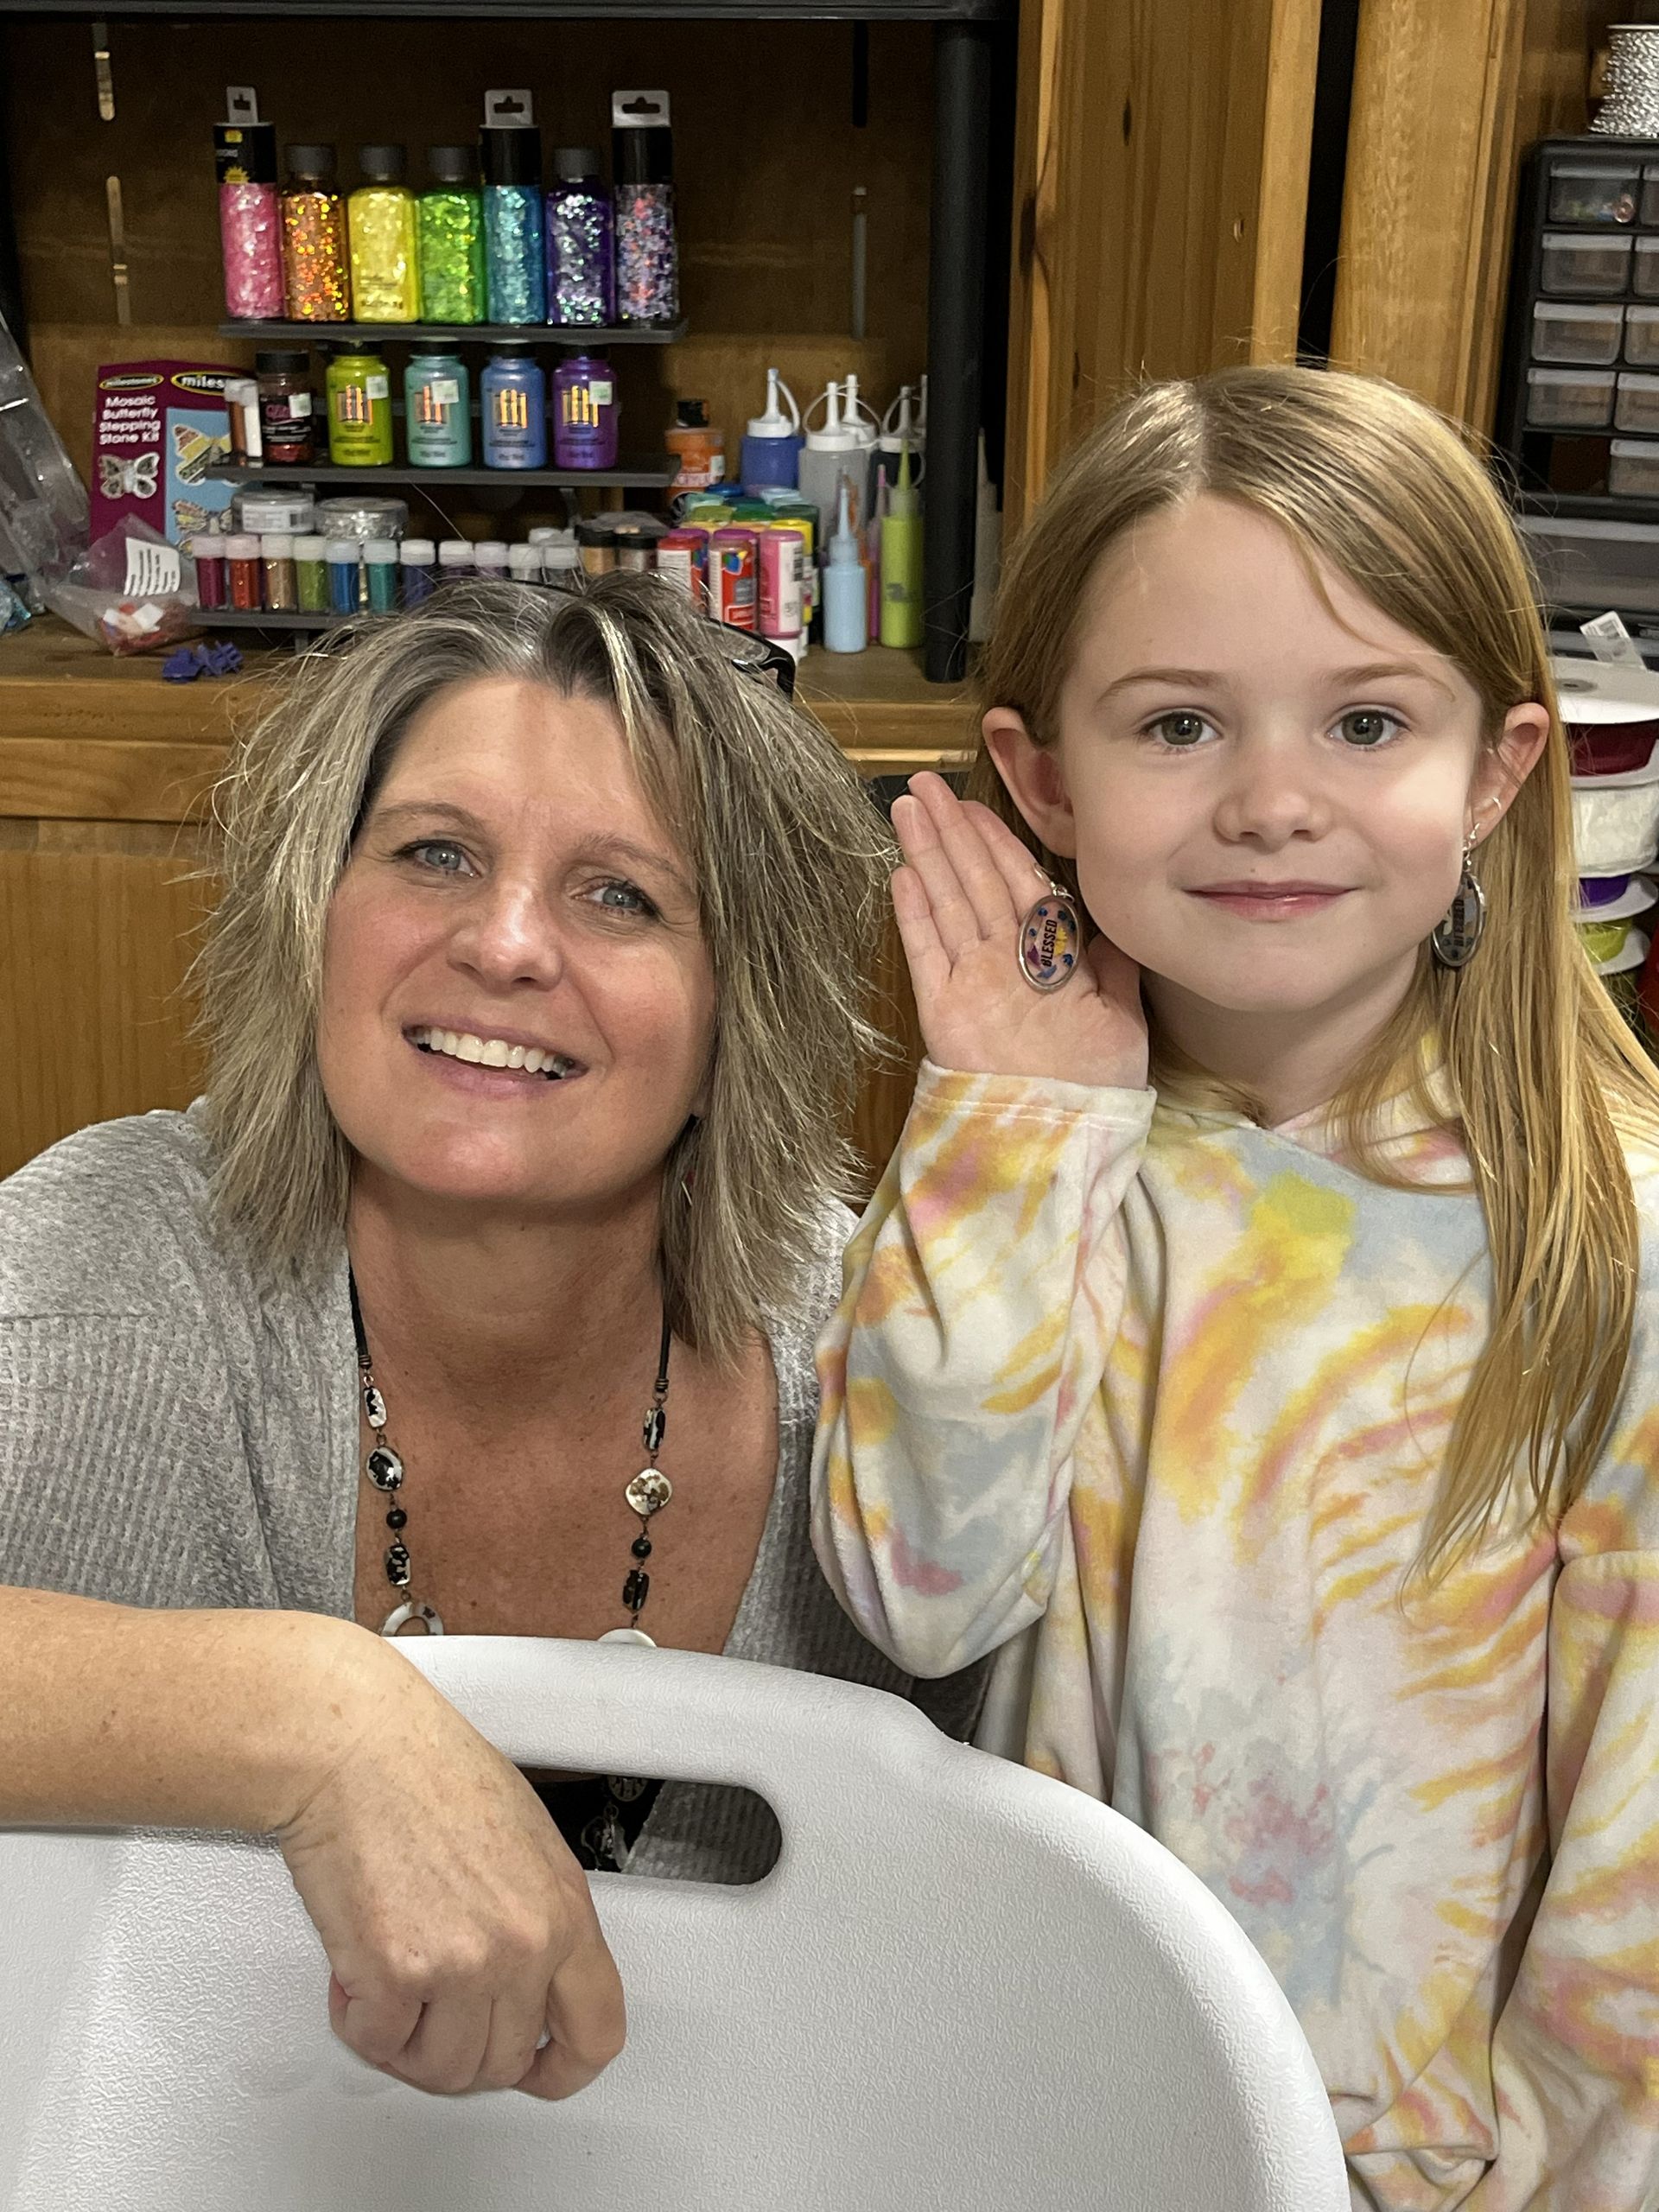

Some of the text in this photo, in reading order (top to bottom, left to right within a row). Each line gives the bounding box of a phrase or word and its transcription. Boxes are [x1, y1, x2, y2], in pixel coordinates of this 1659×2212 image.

[181, 375, 226, 389] miles
[105, 395, 156, 408] Mosaic
[102, 407, 159, 421] Butterfly
[99, 420, 162, 433] Stepping
[99, 431, 160, 445] Stone Kit
[1040, 918, 1058, 967] BLESSED
